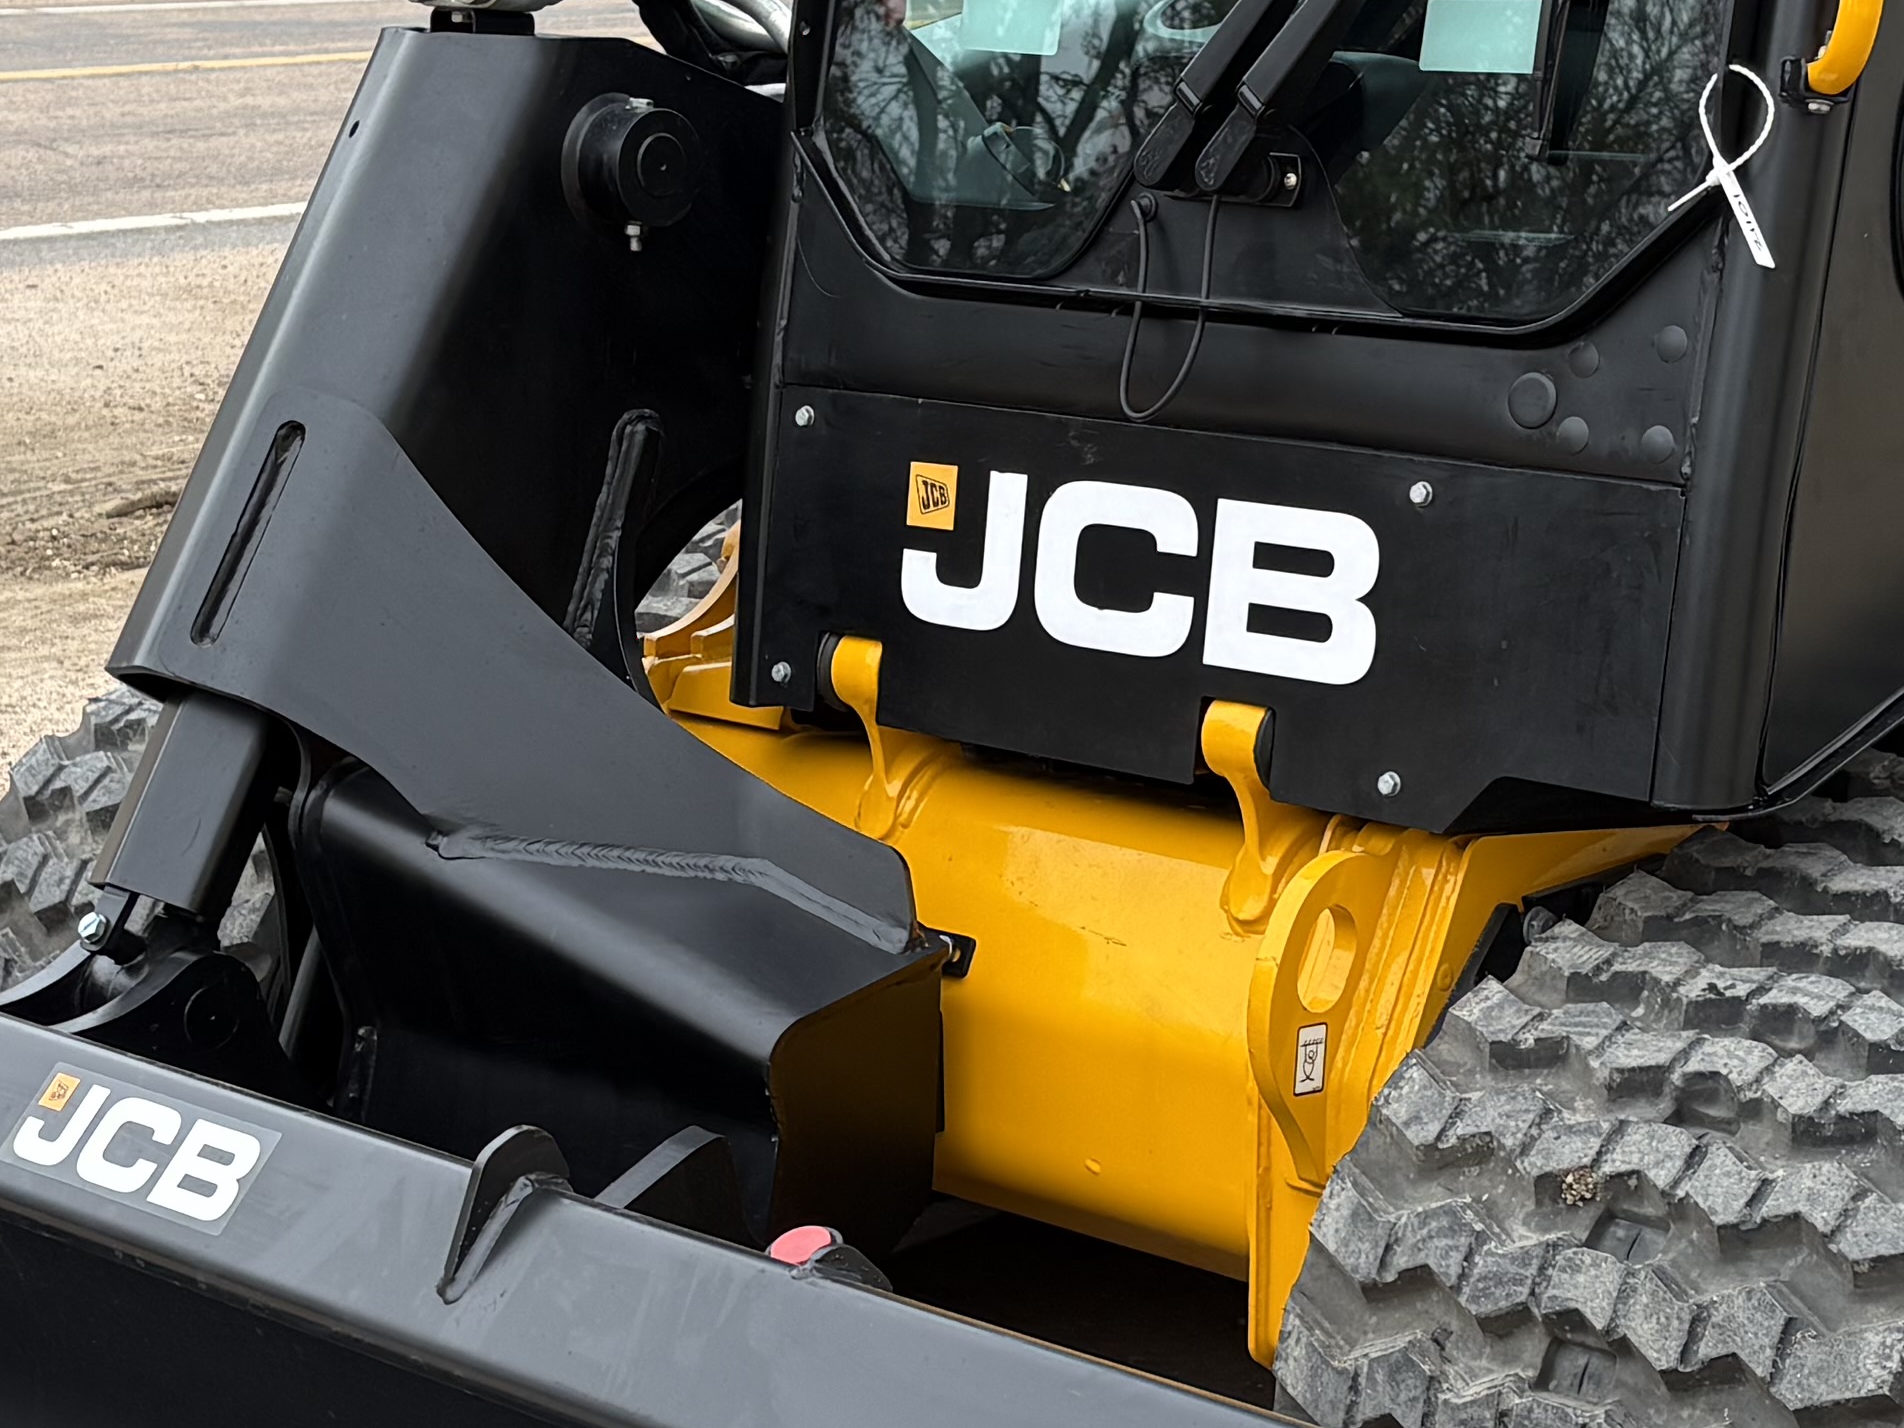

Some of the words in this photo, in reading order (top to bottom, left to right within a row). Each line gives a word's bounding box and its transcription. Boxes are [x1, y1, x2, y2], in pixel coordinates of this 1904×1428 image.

[921, 479, 947, 510] JCB
[900, 469, 1380, 686] JCB
[13, 1083, 261, 1221] JCB
